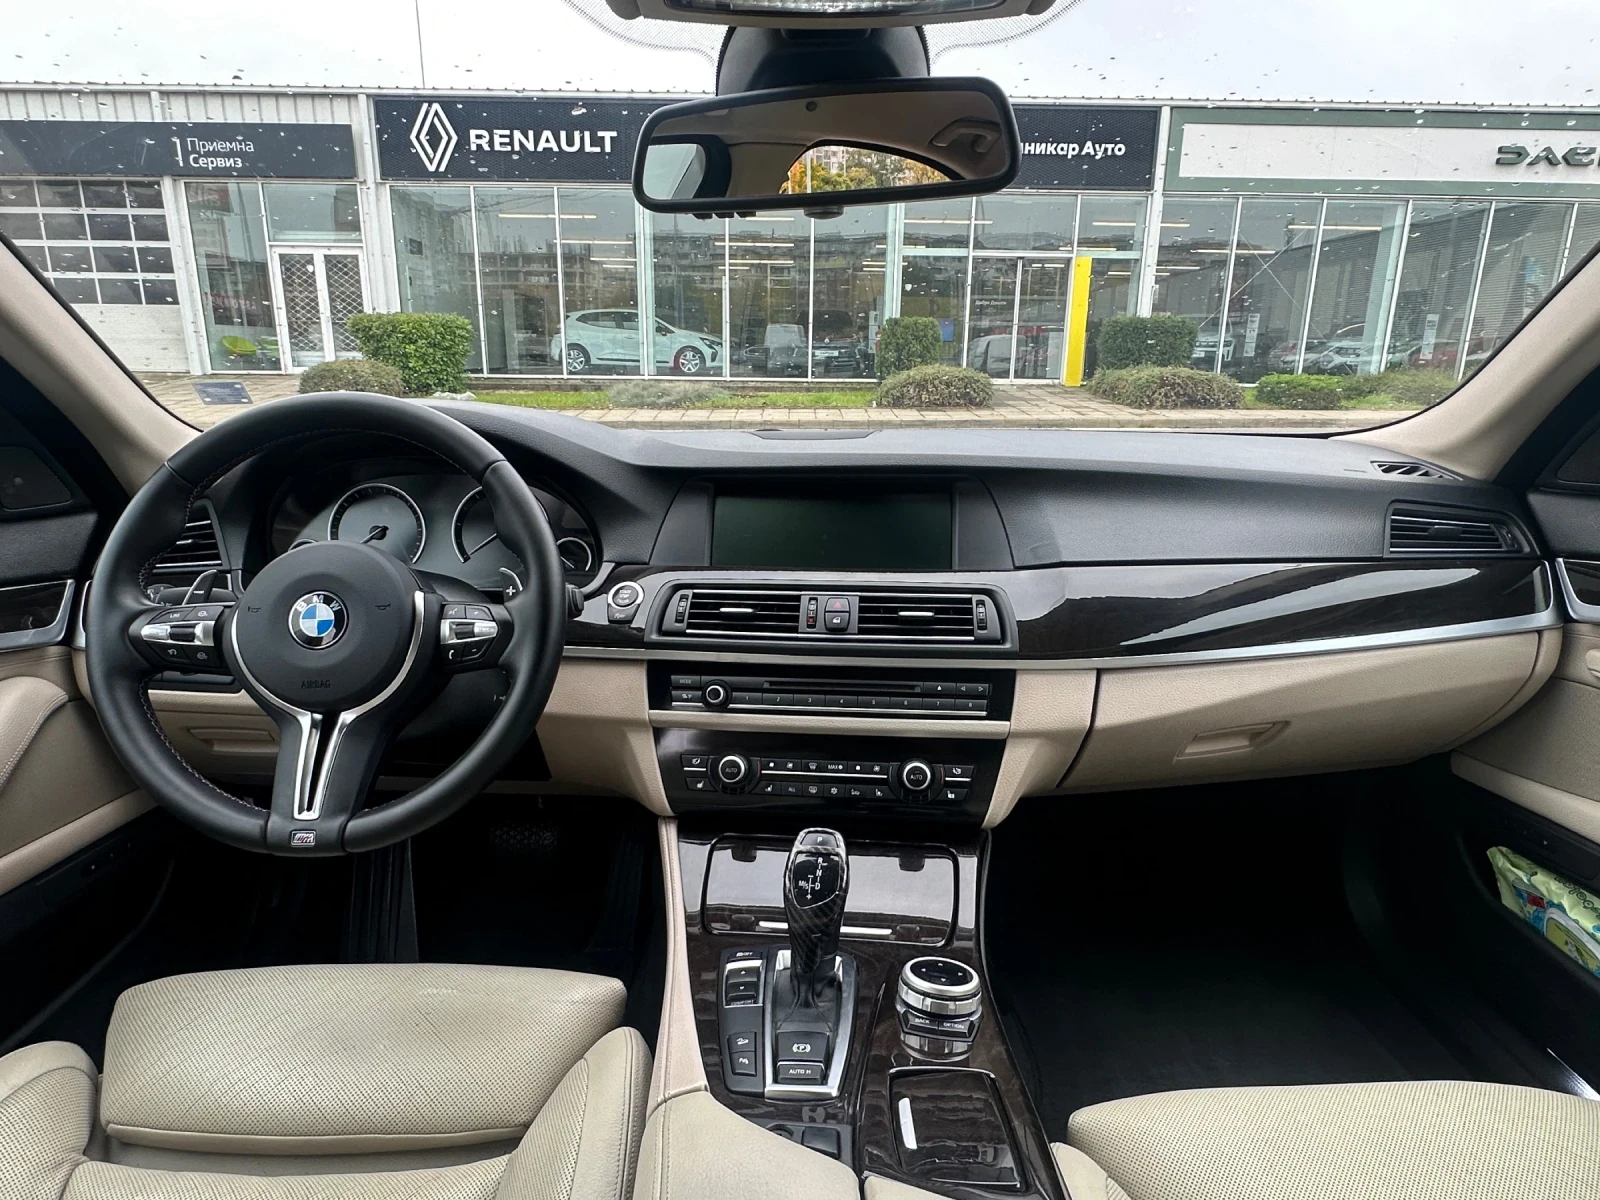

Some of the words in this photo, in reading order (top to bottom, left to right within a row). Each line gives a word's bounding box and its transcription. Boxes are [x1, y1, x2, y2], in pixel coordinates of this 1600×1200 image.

[186, 137, 255, 154] Приемна
[469, 129, 618, 152] RENAULT
[1020, 142, 1079, 159] никар
[1080, 141, 1126, 160] Ауто
[1495, 145, 1600, 166] DAC
[189, 153, 243, 170] Сервиз
[296, 594, 342, 612] BMW
[300, 679, 331, 689] AIRBAG
[816, 869, 823, 877] N
[815, 882, 821, 890] D
